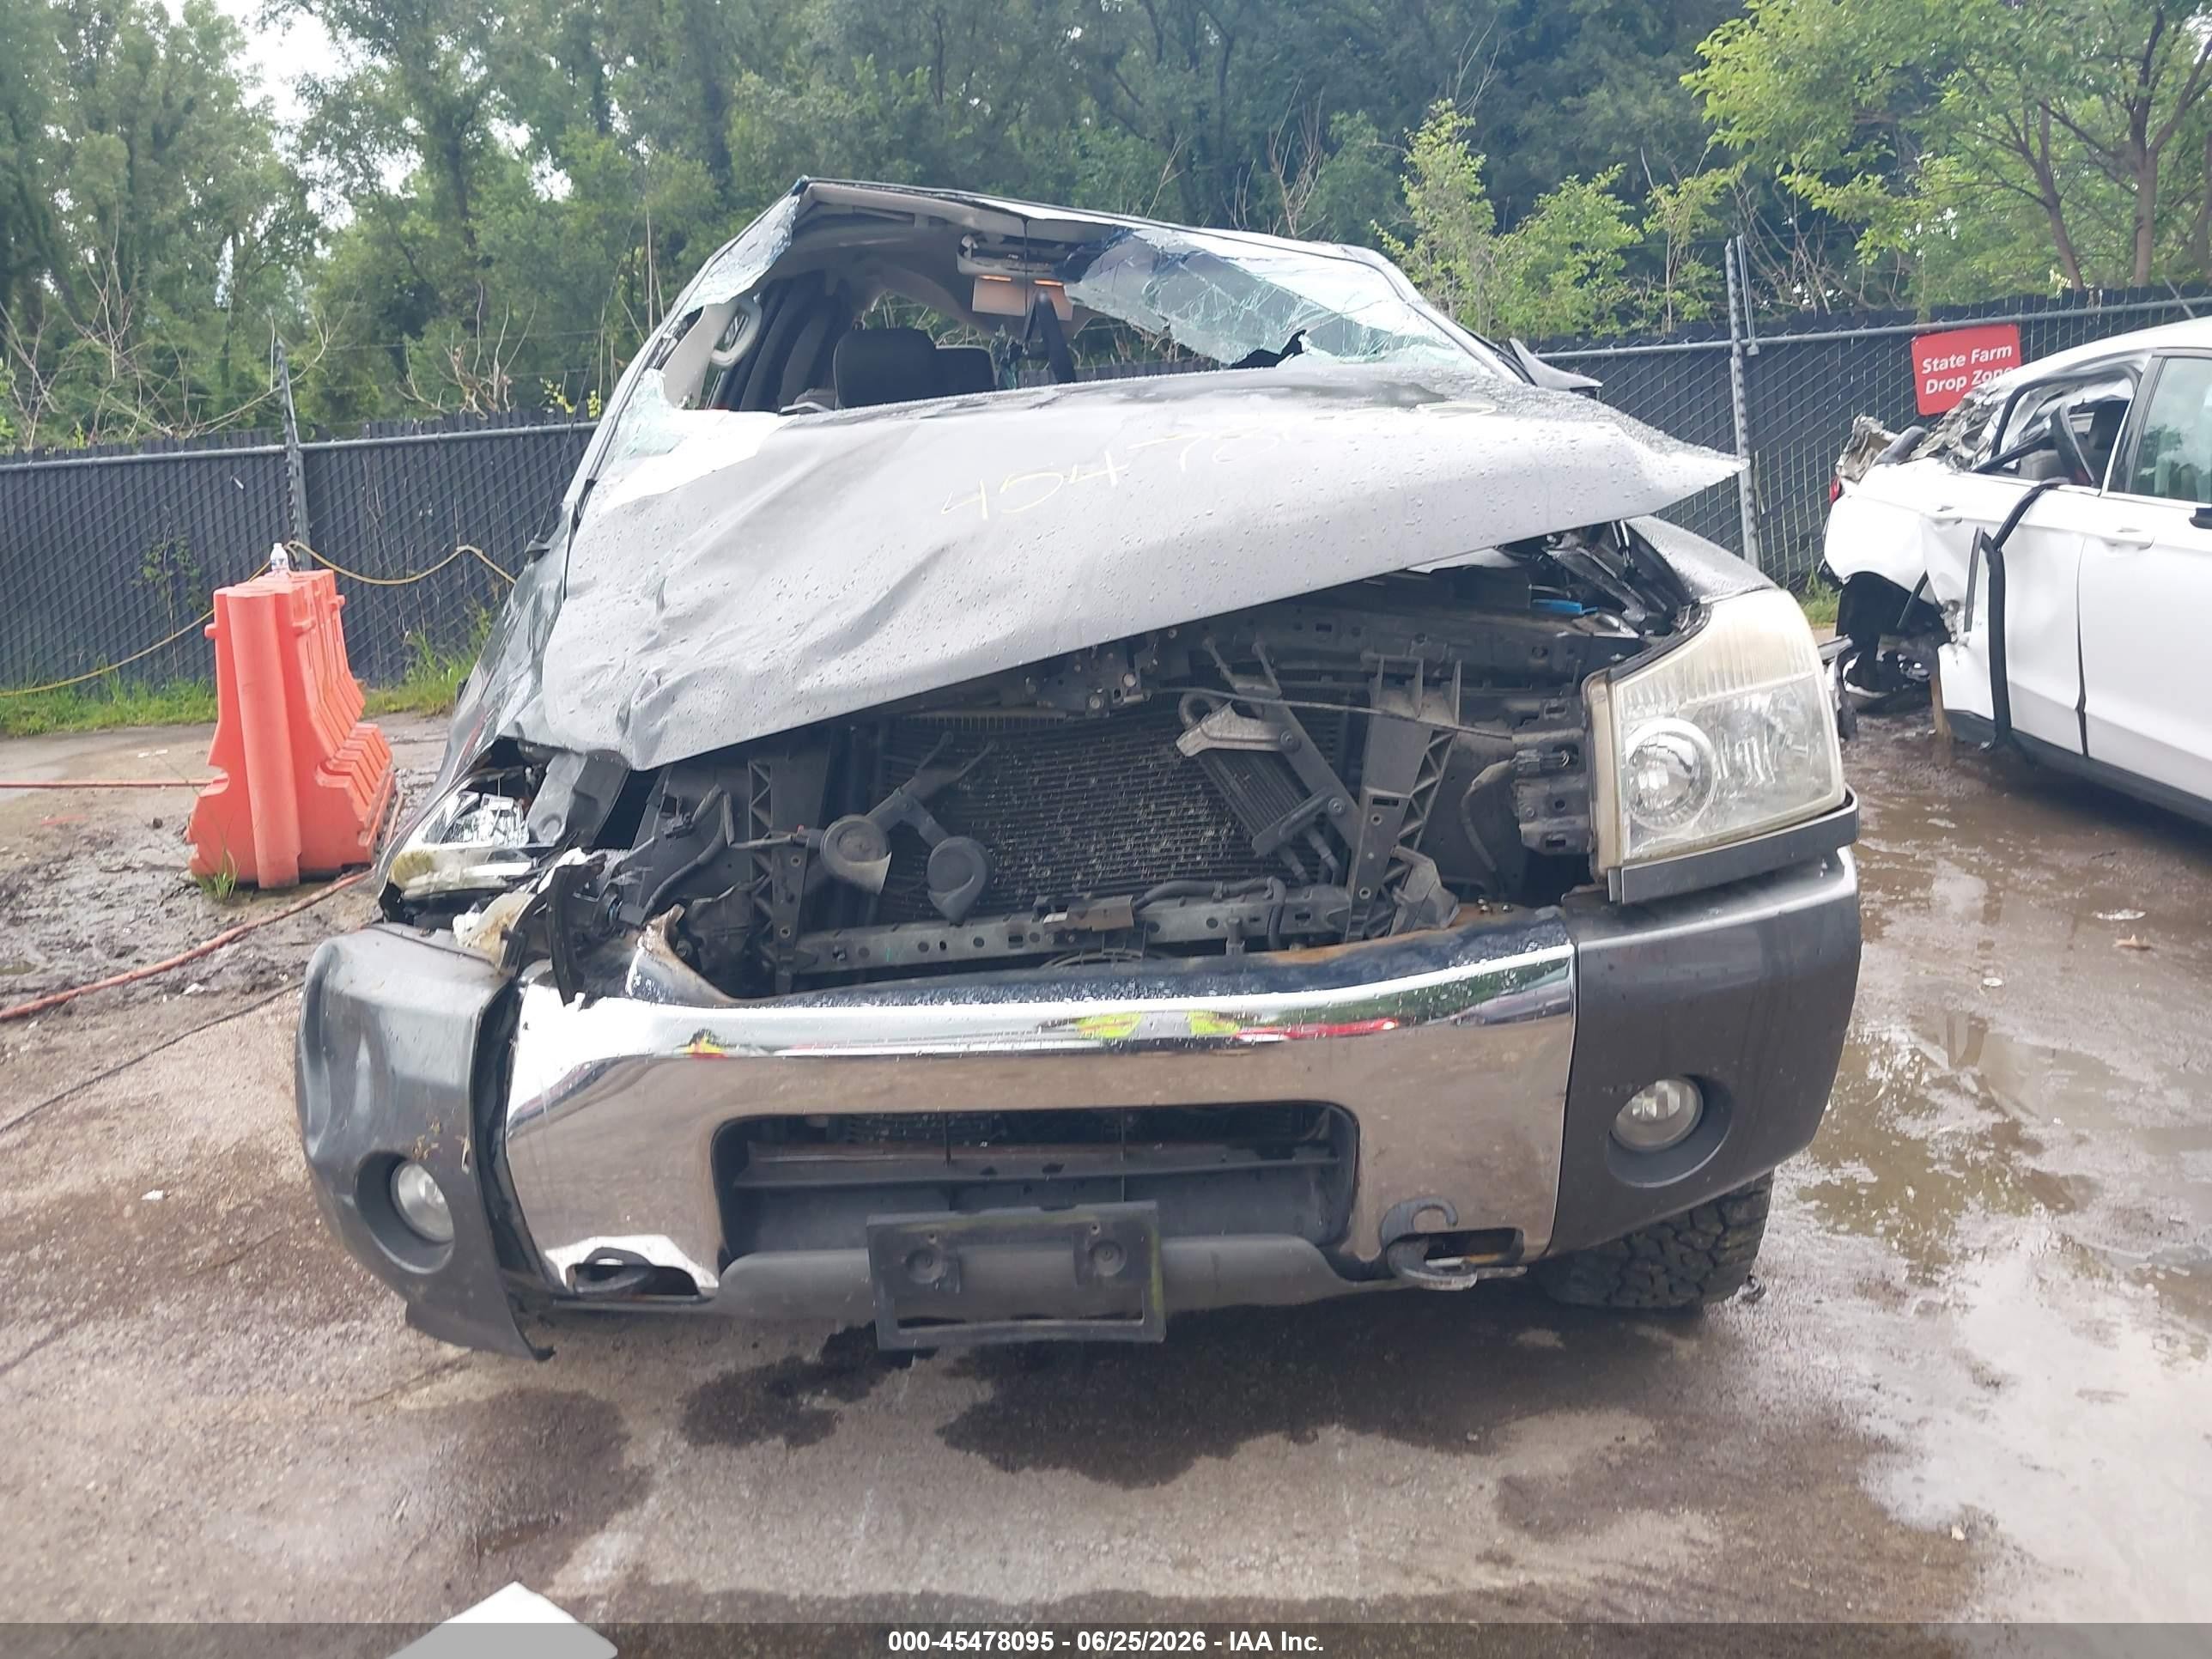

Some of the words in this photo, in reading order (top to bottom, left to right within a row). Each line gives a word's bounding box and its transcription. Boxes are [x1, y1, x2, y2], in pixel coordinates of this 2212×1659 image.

[1922, 354, 1966, 374] State
[1971, 345, 2012, 364] Farm
[1925, 375, 1967, 395] Drop
